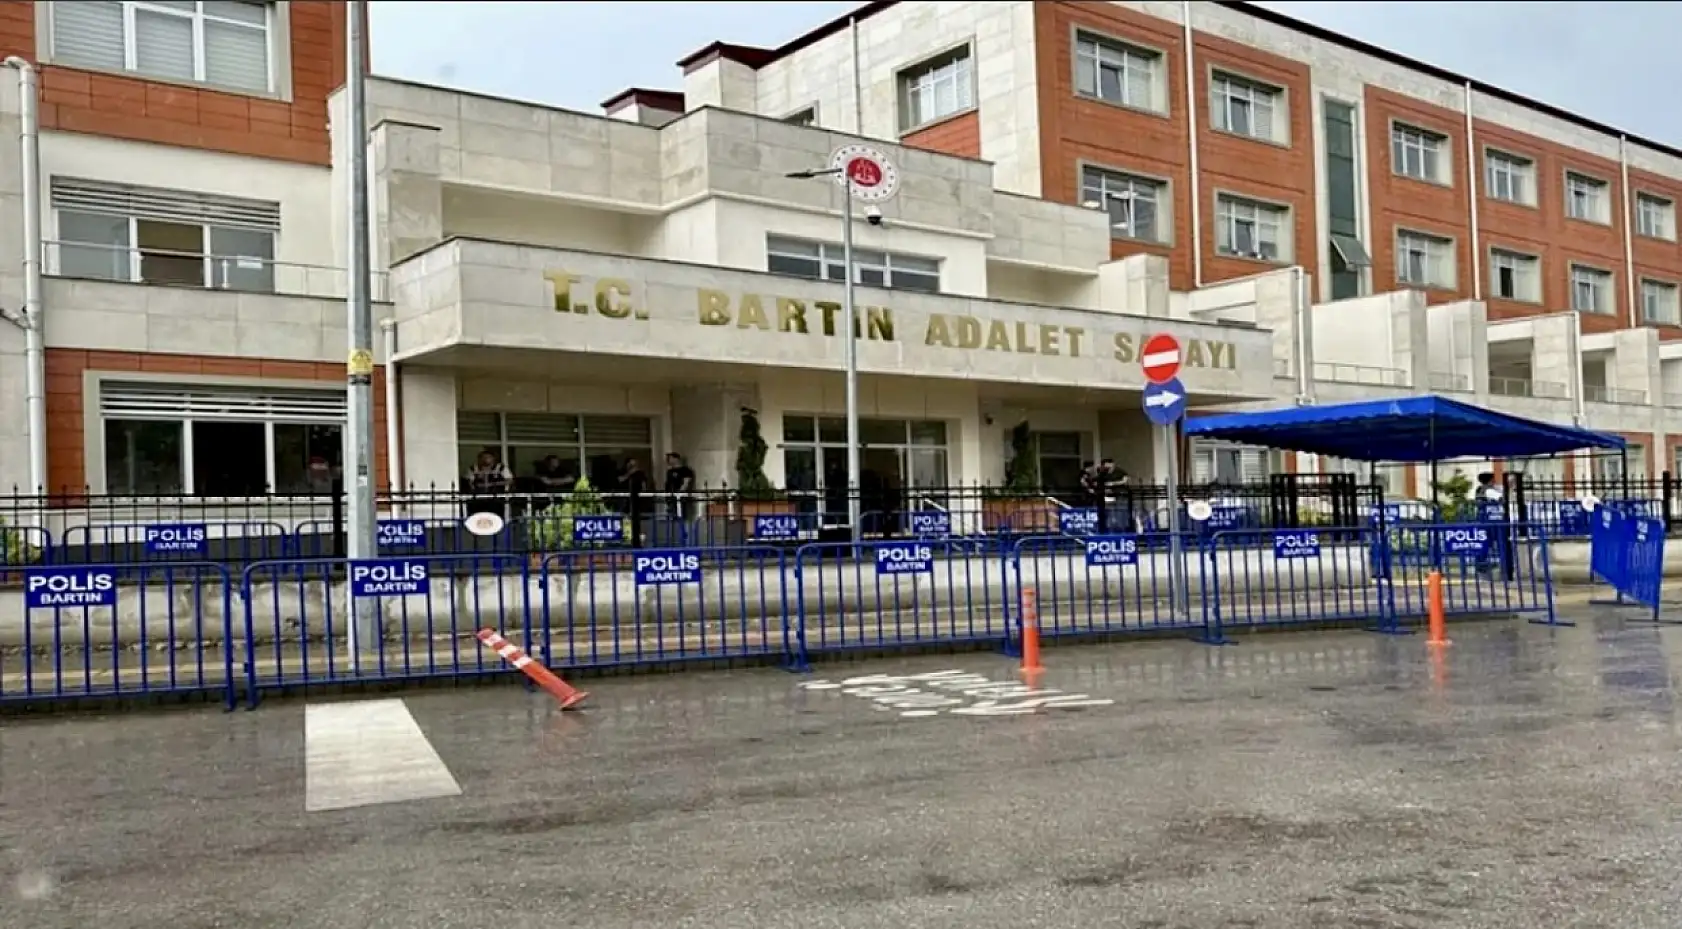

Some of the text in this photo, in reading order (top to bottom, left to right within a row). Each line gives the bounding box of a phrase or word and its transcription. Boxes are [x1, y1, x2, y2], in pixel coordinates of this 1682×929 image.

[544, 269, 1236, 371] T.C. BARTIN ADALET SAYI
[575, 517, 622, 532] POLİS
[147, 524, 204, 542] POLİS
[1276, 532, 1319, 548] POLİS
[1445, 527, 1488, 542] POLİS
[878, 545, 932, 561] POLİS
[1088, 538, 1136, 555] POLİS
[636, 553, 701, 572] POLİS
[886, 561, 926, 571] BARTIN
[354, 561, 427, 583] POLİS
[645, 571, 693, 582] BARTIN
[28, 571, 113, 592] POLİS
[364, 581, 418, 594] BARTIN
[40, 592, 103, 606] BARTIN
